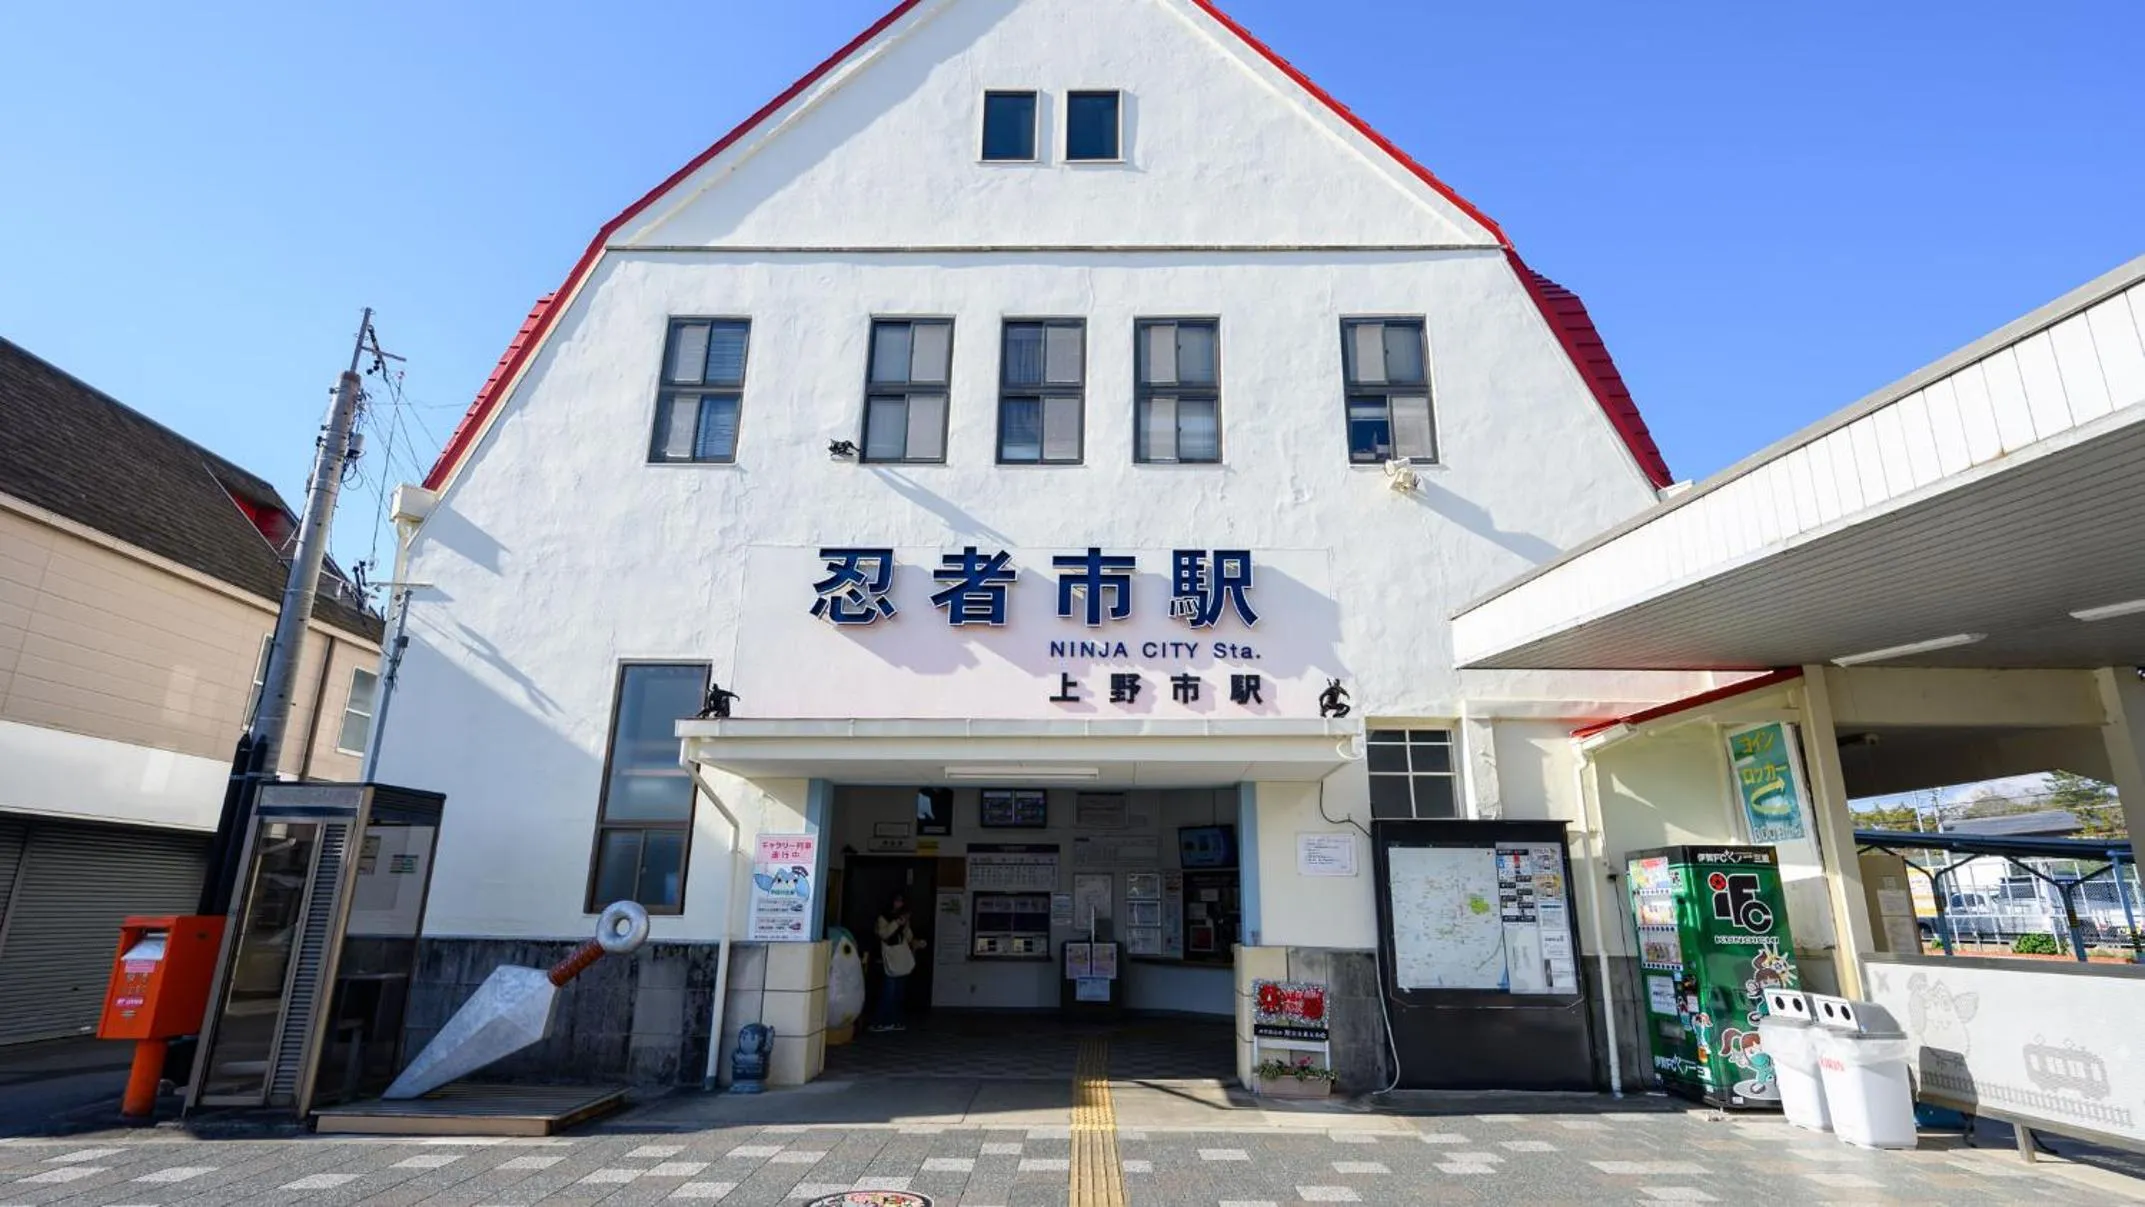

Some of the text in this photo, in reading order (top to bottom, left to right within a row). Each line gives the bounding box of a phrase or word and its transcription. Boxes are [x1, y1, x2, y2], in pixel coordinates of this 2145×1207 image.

[808, 545, 1262, 630] 忍者市駅
[1050, 640, 1263, 660] NINJA CITY Sta.
[1049, 672, 1264, 705] 上野市駅
